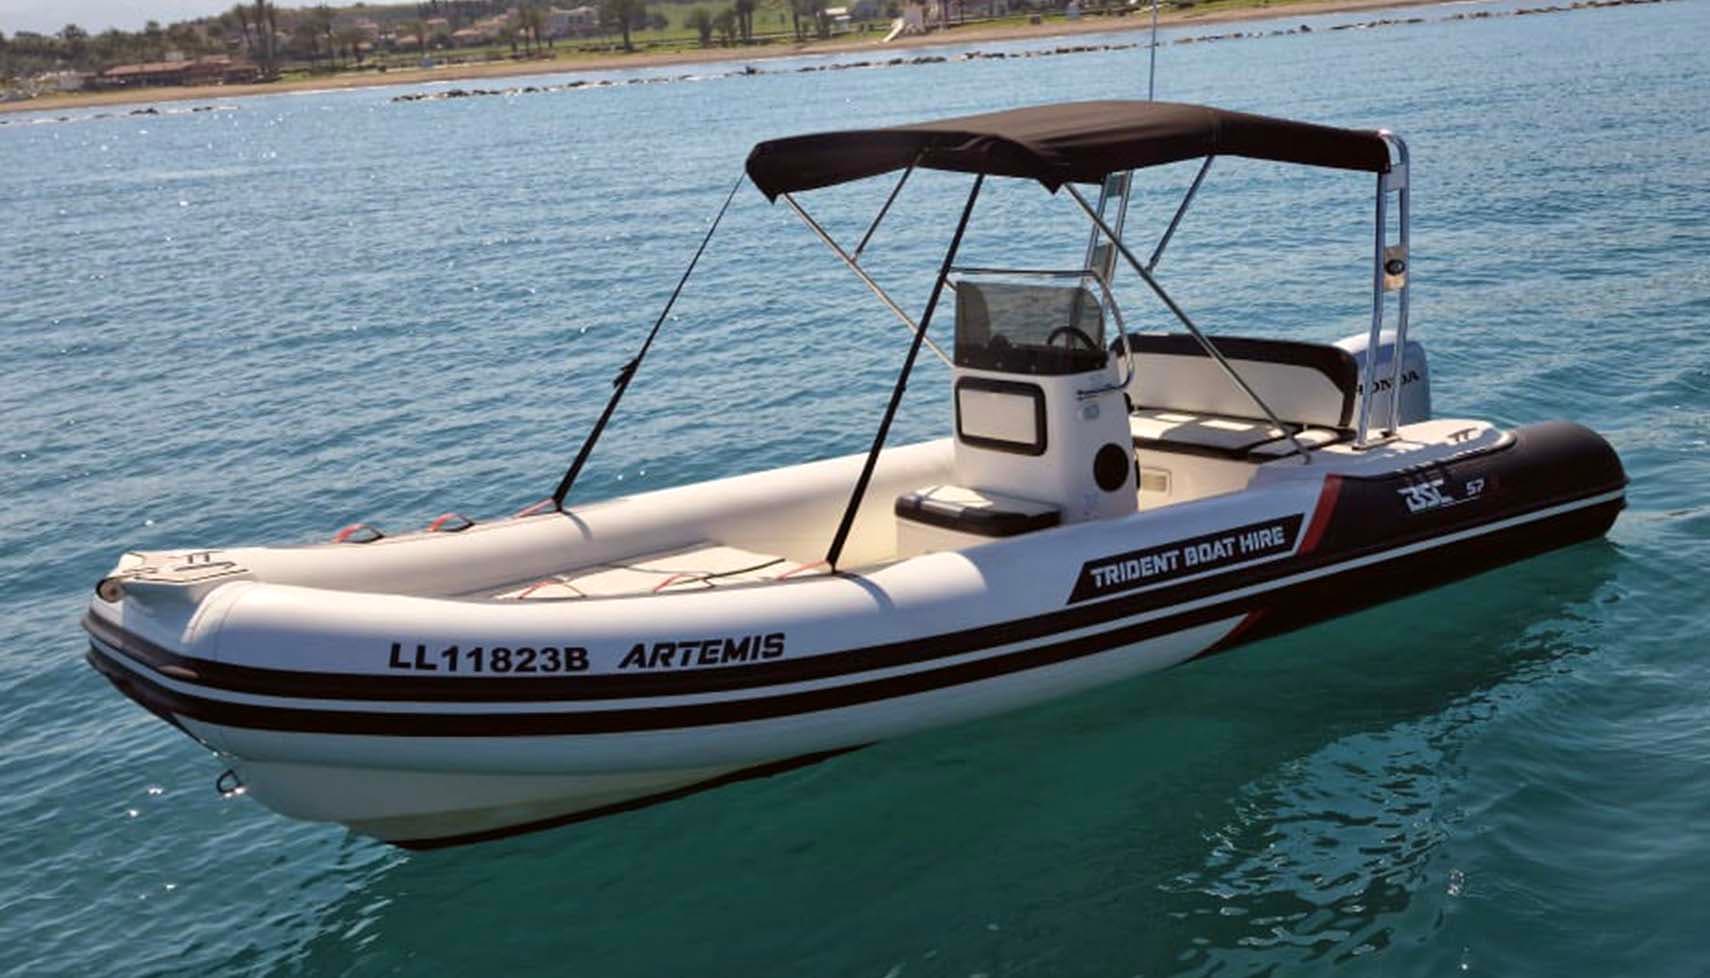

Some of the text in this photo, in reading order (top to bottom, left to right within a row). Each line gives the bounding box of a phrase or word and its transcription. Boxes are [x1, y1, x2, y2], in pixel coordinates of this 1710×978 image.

[1090, 526, 1285, 588] TRIDENT BOAT HIRE
[389, 633, 786, 673] LL11823B ARTEMIS
